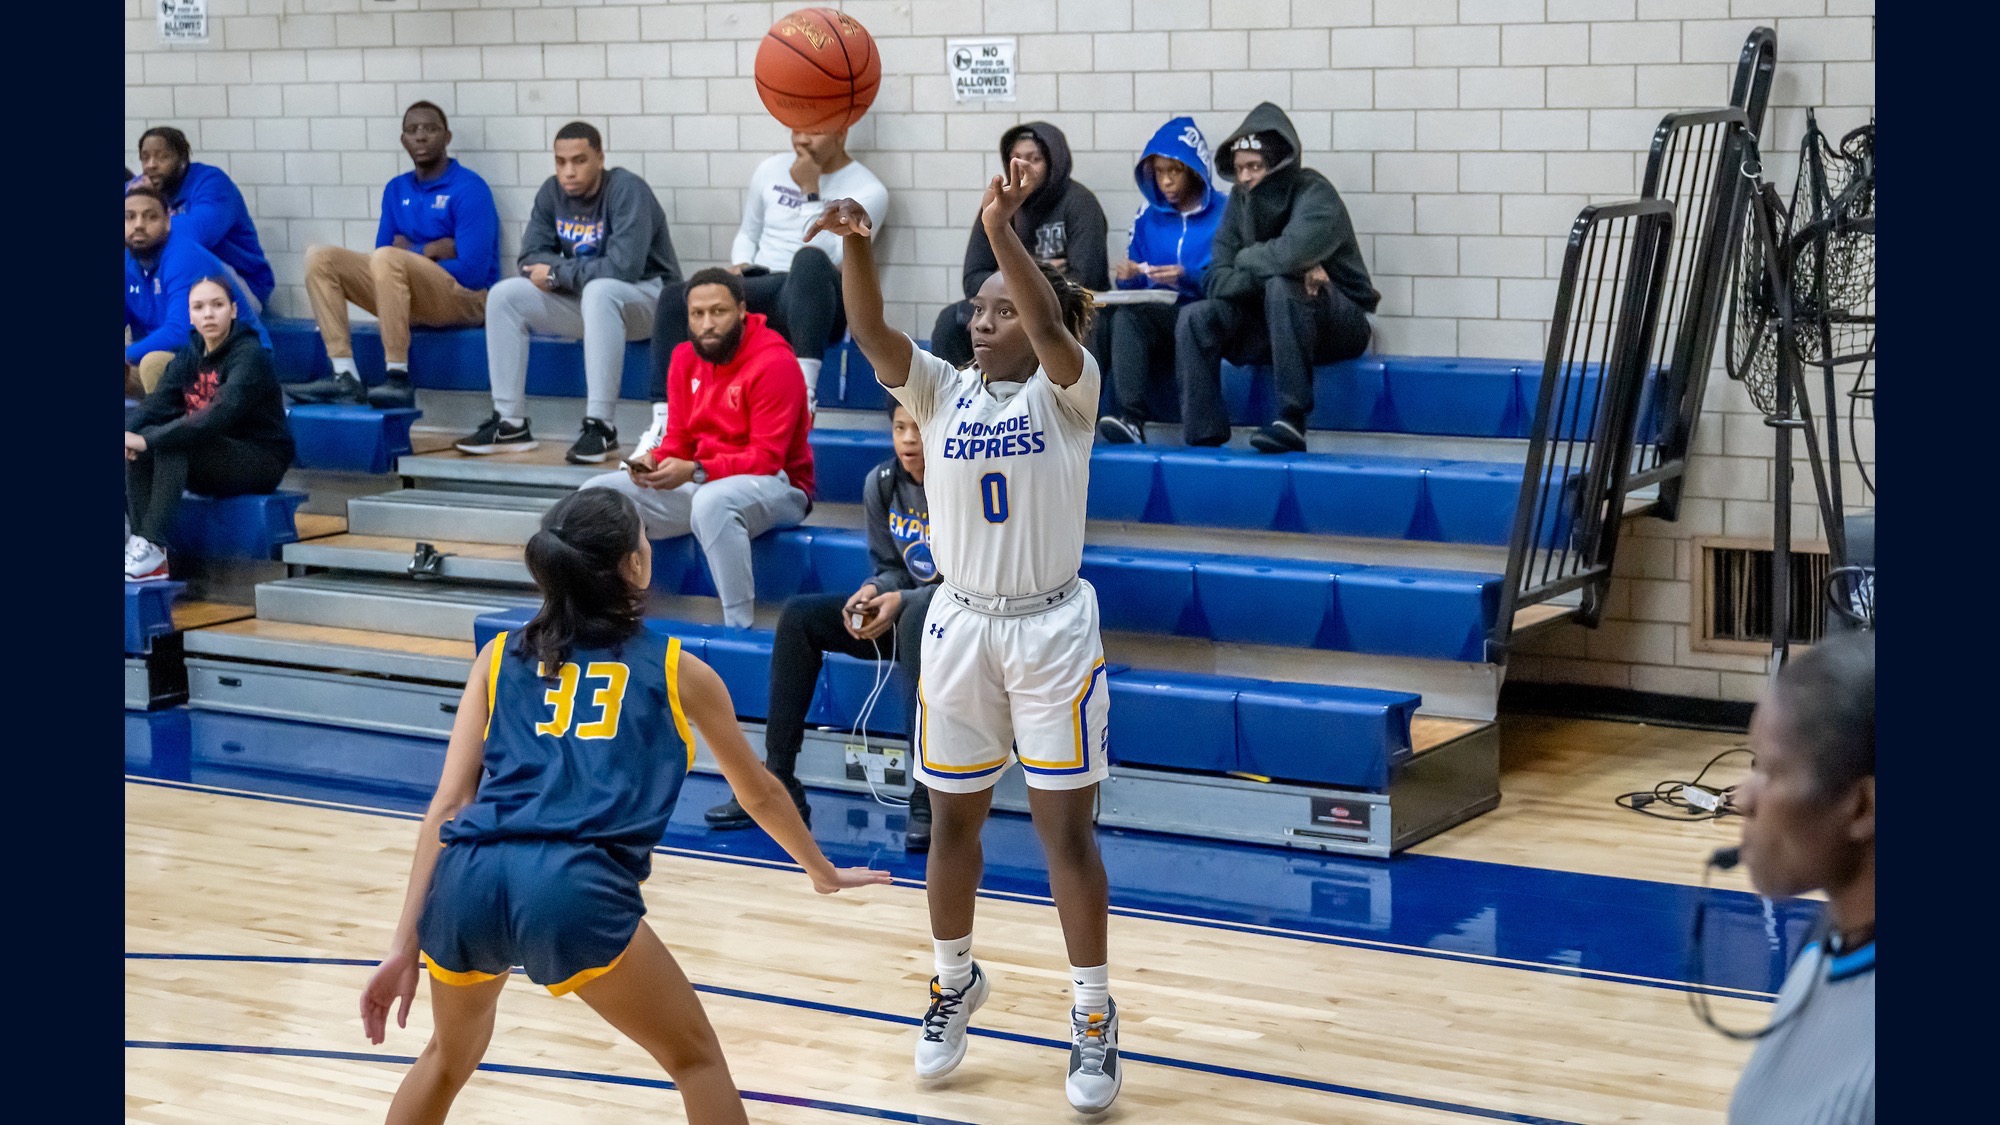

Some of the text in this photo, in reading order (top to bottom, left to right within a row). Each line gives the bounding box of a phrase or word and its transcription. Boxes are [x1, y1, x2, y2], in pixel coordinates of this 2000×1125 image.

[982, 46, 998, 57] NO
[957, 76, 1007, 87] ALLOWED
[957, 415, 1029, 437] MONROE
[943, 431, 1046, 460] EXPRESS
[979, 470, 1011, 525] 0
[535, 661, 631, 740] 33
